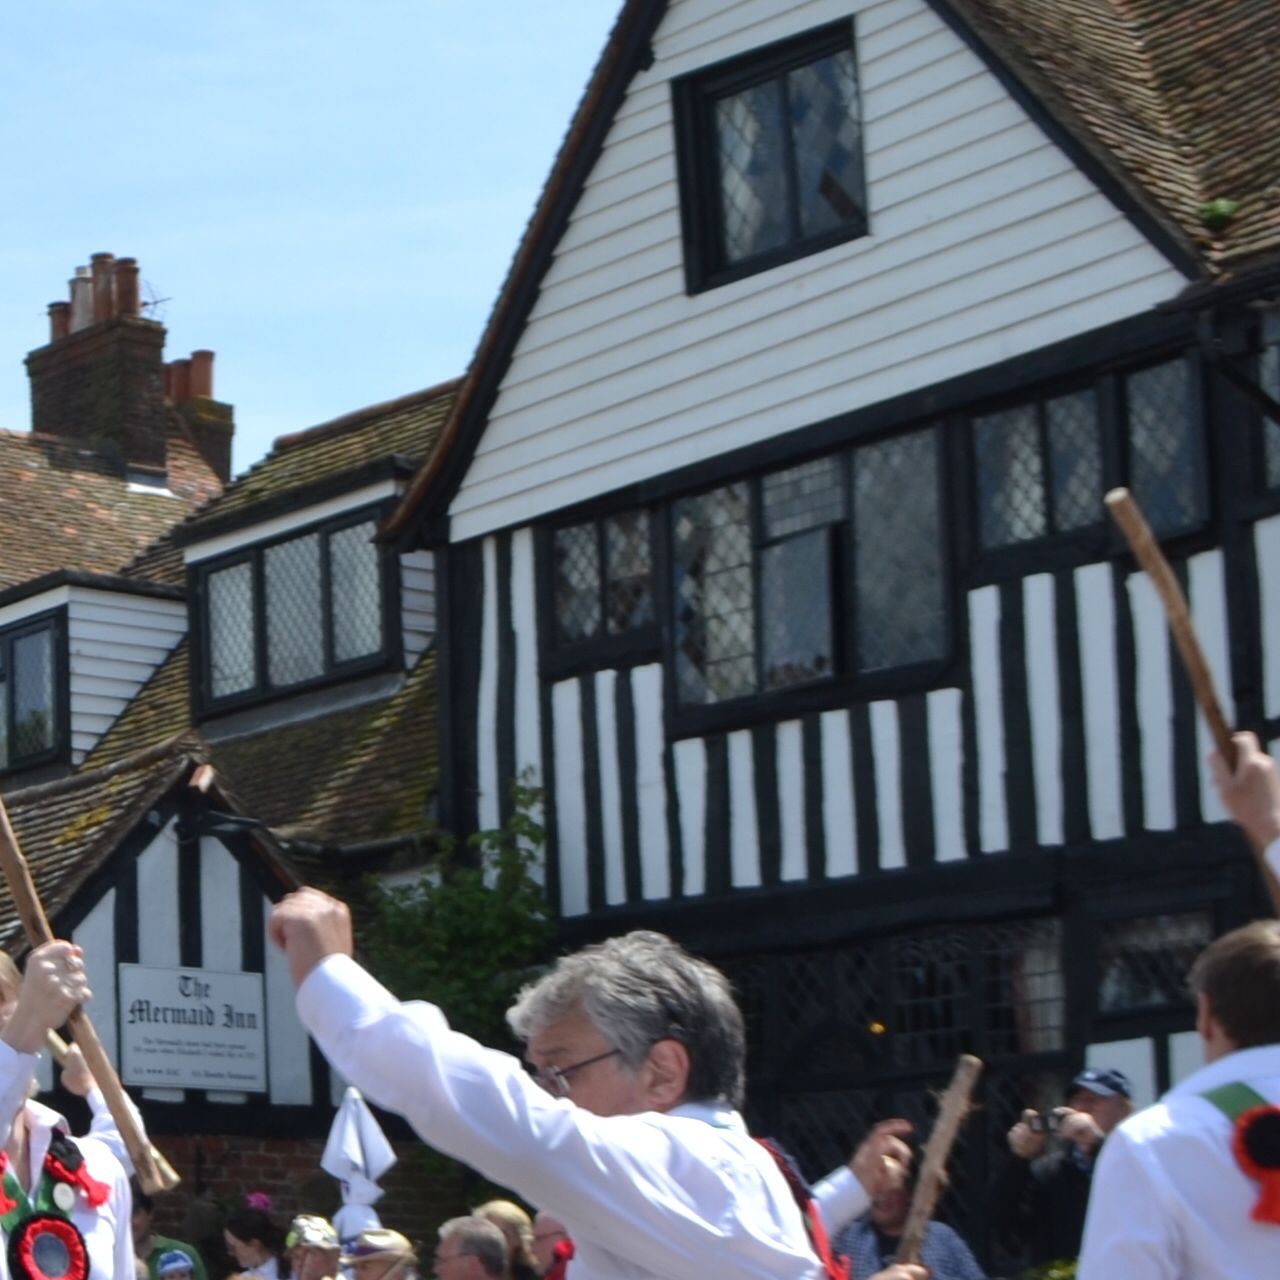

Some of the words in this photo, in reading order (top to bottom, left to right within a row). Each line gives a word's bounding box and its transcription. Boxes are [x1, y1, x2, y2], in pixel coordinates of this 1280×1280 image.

[177, 974, 211, 999] The
[127, 999, 216, 1027] Mermaid
[221, 1003, 258, 1030] Inn
